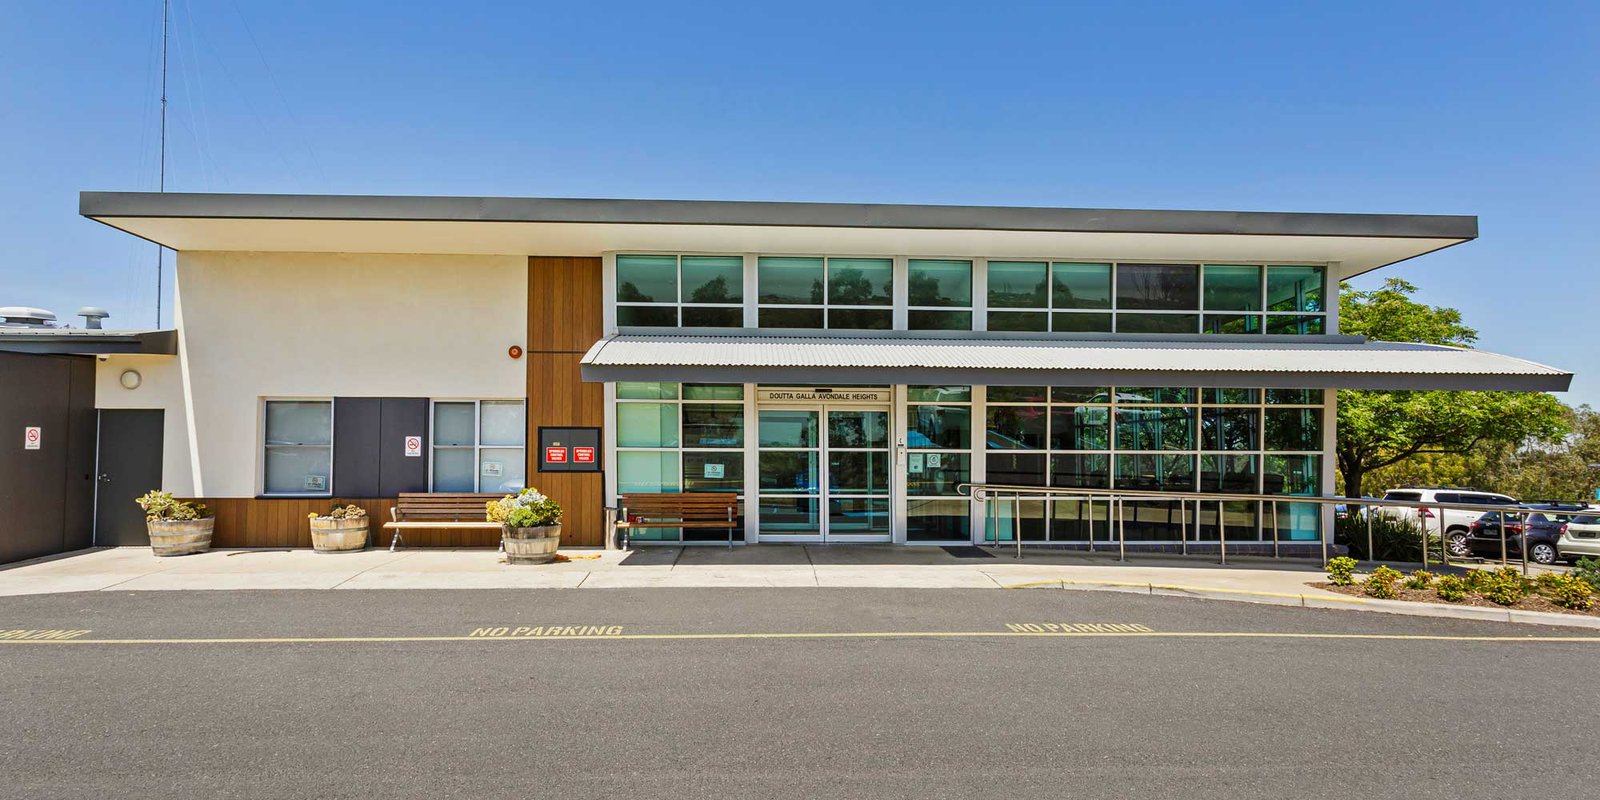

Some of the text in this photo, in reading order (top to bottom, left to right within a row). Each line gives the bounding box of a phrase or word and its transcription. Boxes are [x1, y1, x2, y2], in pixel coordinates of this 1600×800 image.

[469, 625, 624, 637] NO PARKING
[1005, 623, 1156, 633] NO PARKING
